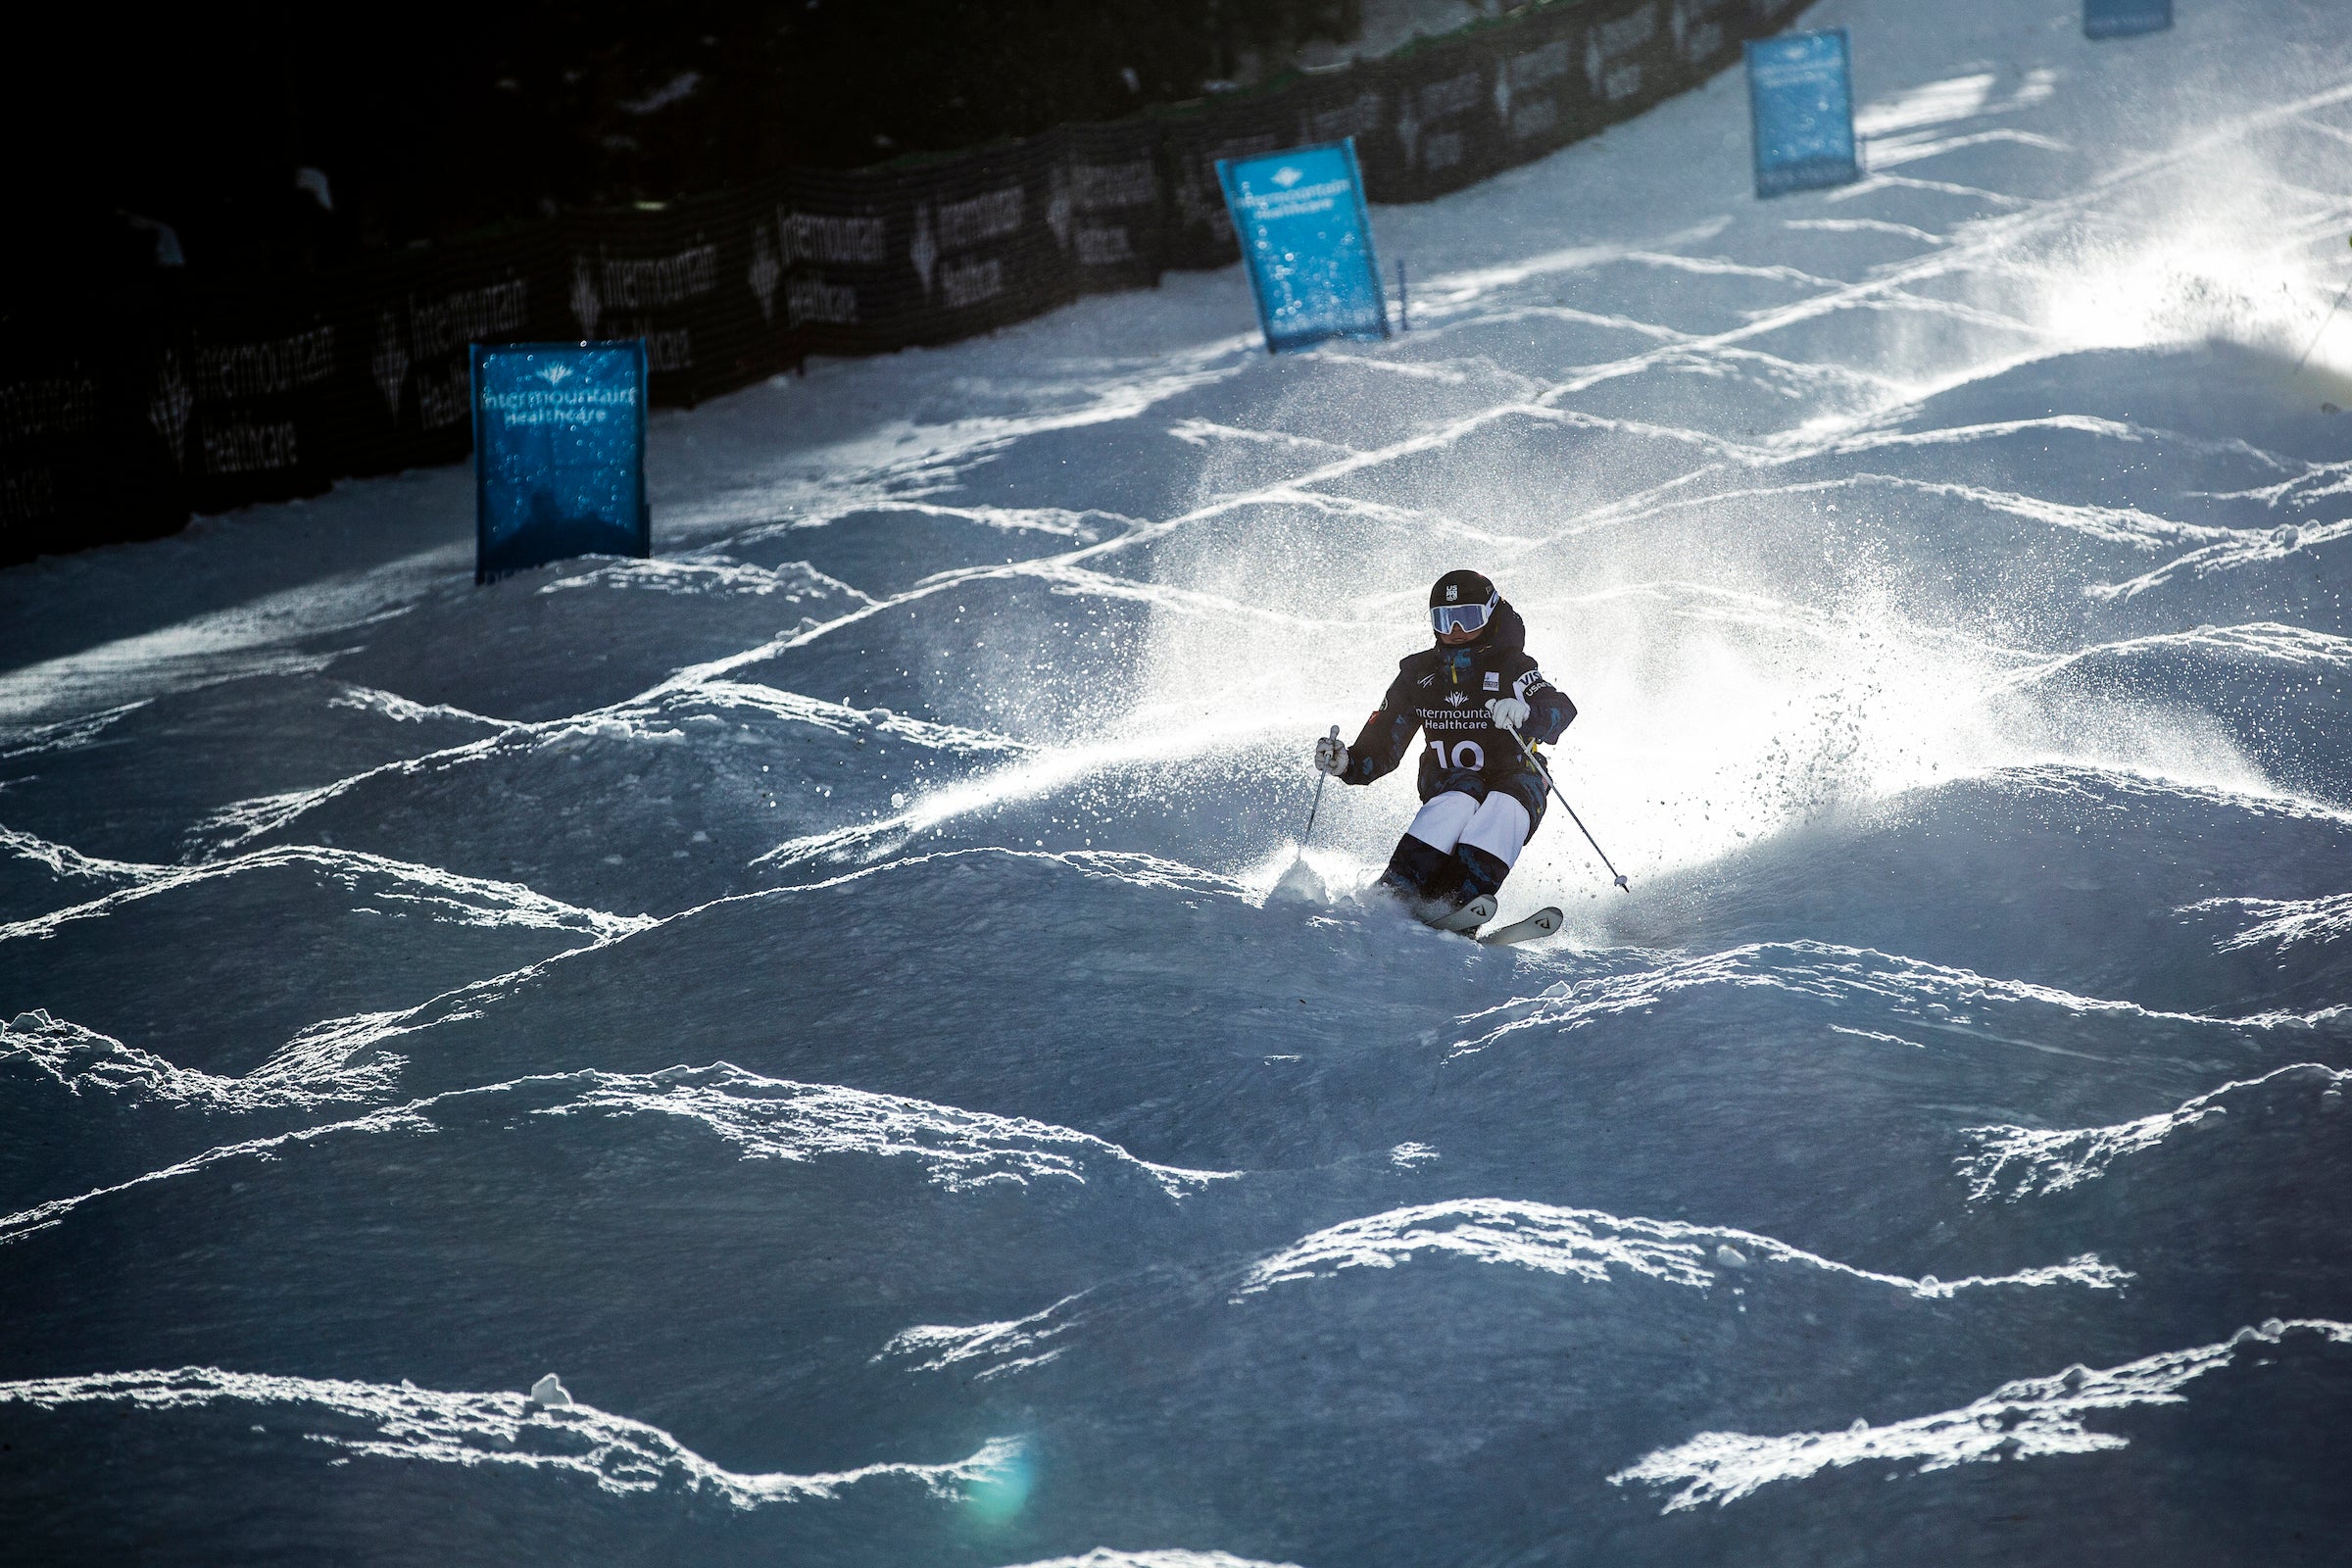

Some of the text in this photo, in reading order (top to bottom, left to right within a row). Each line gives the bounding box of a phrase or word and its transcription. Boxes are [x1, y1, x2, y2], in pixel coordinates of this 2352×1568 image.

[1519, 671, 1541, 686] VIS
[1414, 707, 1492, 719] ntermounta
[1425, 719, 1488, 730] Healthcare
[1429, 740, 1485, 771] 10
